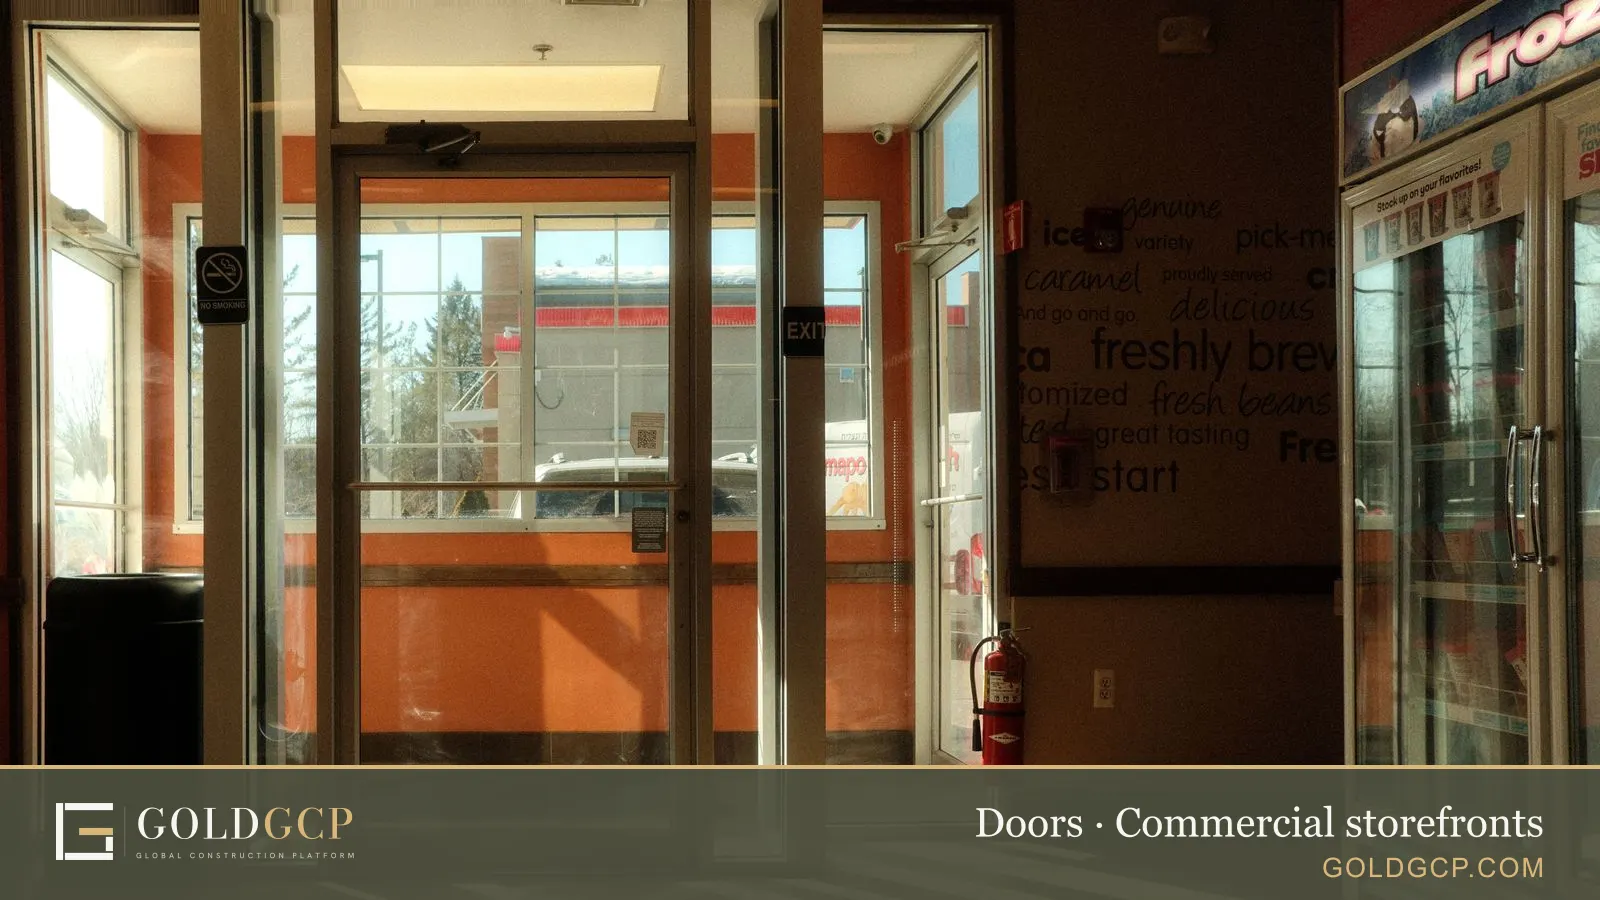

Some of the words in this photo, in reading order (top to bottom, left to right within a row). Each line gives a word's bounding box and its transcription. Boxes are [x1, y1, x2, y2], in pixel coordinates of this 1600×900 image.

[1377, 196, 1398, 213] Stock
[1399, 193, 1409, 205] up
[1409, 189, 1419, 199] on
[1420, 180, 1438, 198] your
[1439, 158, 1482, 187] flavorites!
[1121, 196, 1222, 231] genuine
[1135, 234, 1194, 255] variety
[1025, 261, 1142, 293] caramel
[1162, 265, 1217, 285] proudly
[1221, 265, 1272, 282] served
[200, 302, 211, 310] NO
[212, 301, 246, 310] SMOKING
[1051, 307, 1073, 326] go
[1077, 304, 1110, 322] and
[1169, 287, 1314, 322] delicious
[787, 322, 825, 339] EXIT
[1091, 326, 1232, 382] freshly
[1148, 380, 1226, 417] fresh
[1238, 380, 1332, 417] beans
[1095, 424, 1159, 450] great
[1168, 424, 1250, 451] tasting
[1093, 459, 1181, 493] start
